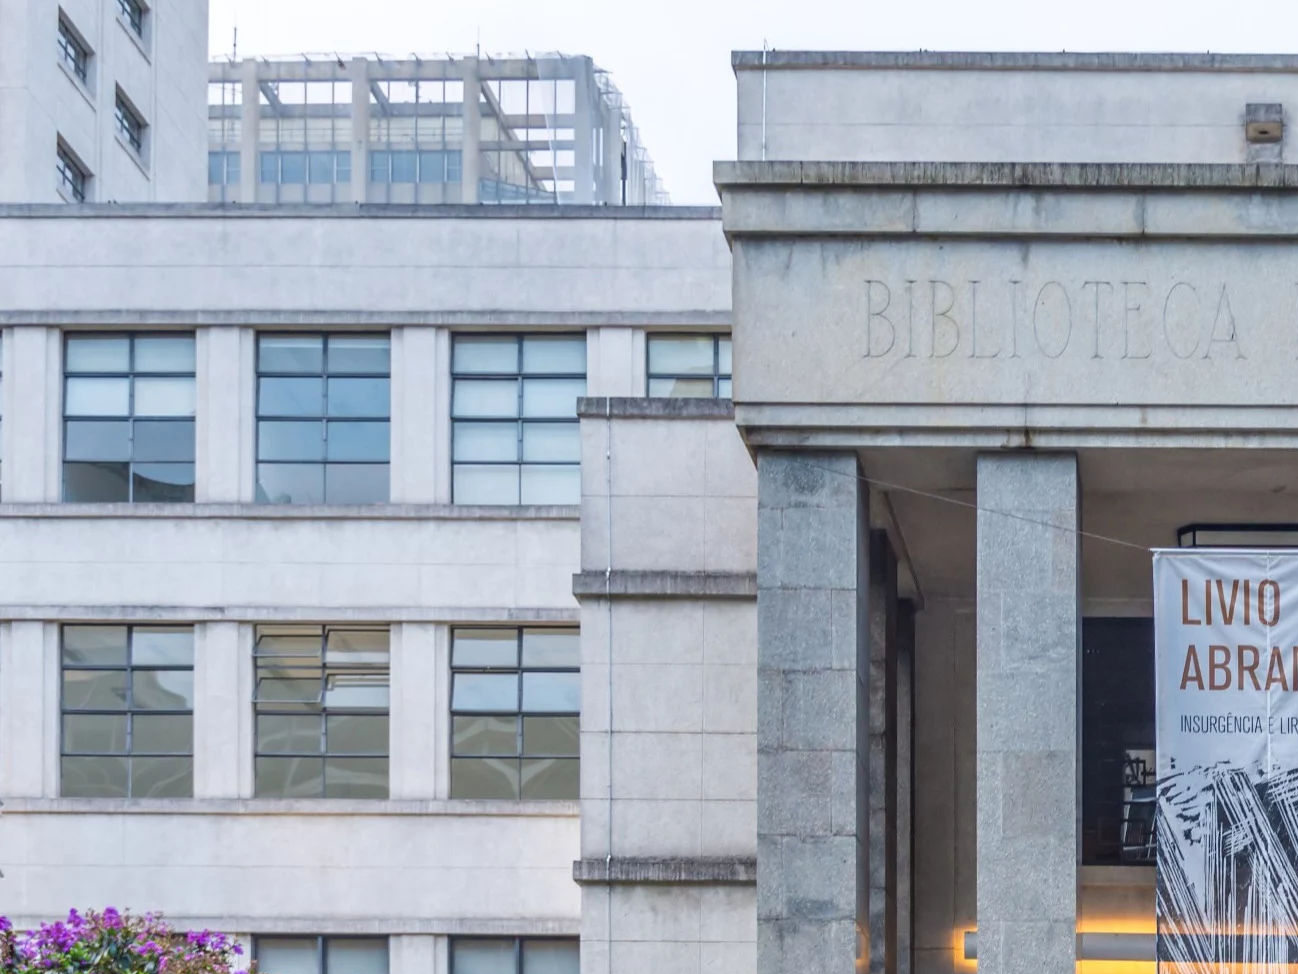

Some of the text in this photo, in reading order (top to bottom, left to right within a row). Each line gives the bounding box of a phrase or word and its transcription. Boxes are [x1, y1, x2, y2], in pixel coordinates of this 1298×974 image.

[862, 279, 1247, 361] BIBLIOTECA
[1181, 578, 1281, 627] LIVIO
[1180, 712, 1263, 735] INSURGÊNCIA
